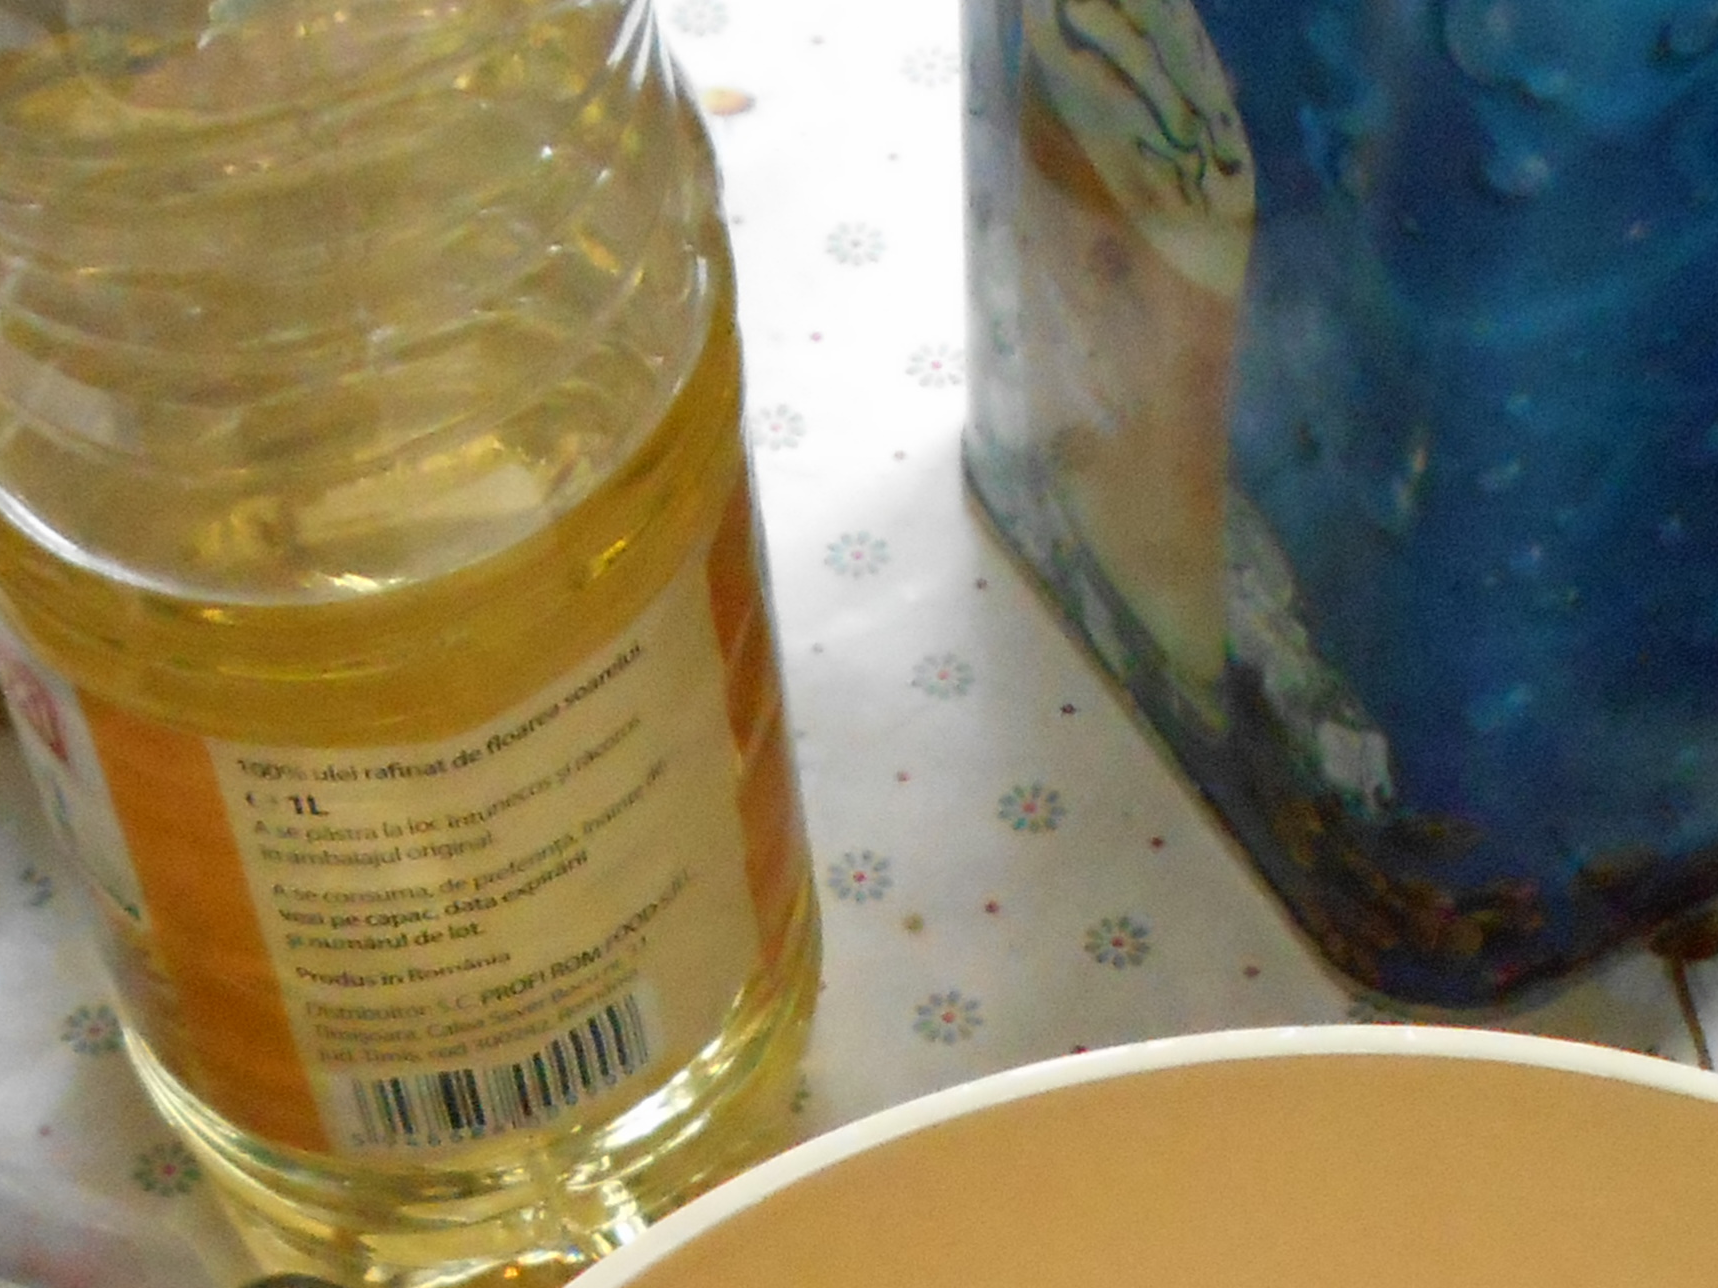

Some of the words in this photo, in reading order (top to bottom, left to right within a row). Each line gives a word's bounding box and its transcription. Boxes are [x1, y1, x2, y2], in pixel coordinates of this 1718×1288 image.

[451, 748, 482, 770] de
[444, 895, 499, 916] data
[413, 926, 444, 947] de
[480, 969, 547, 1006] PROFI
[549, 945, 603, 980] ROM
